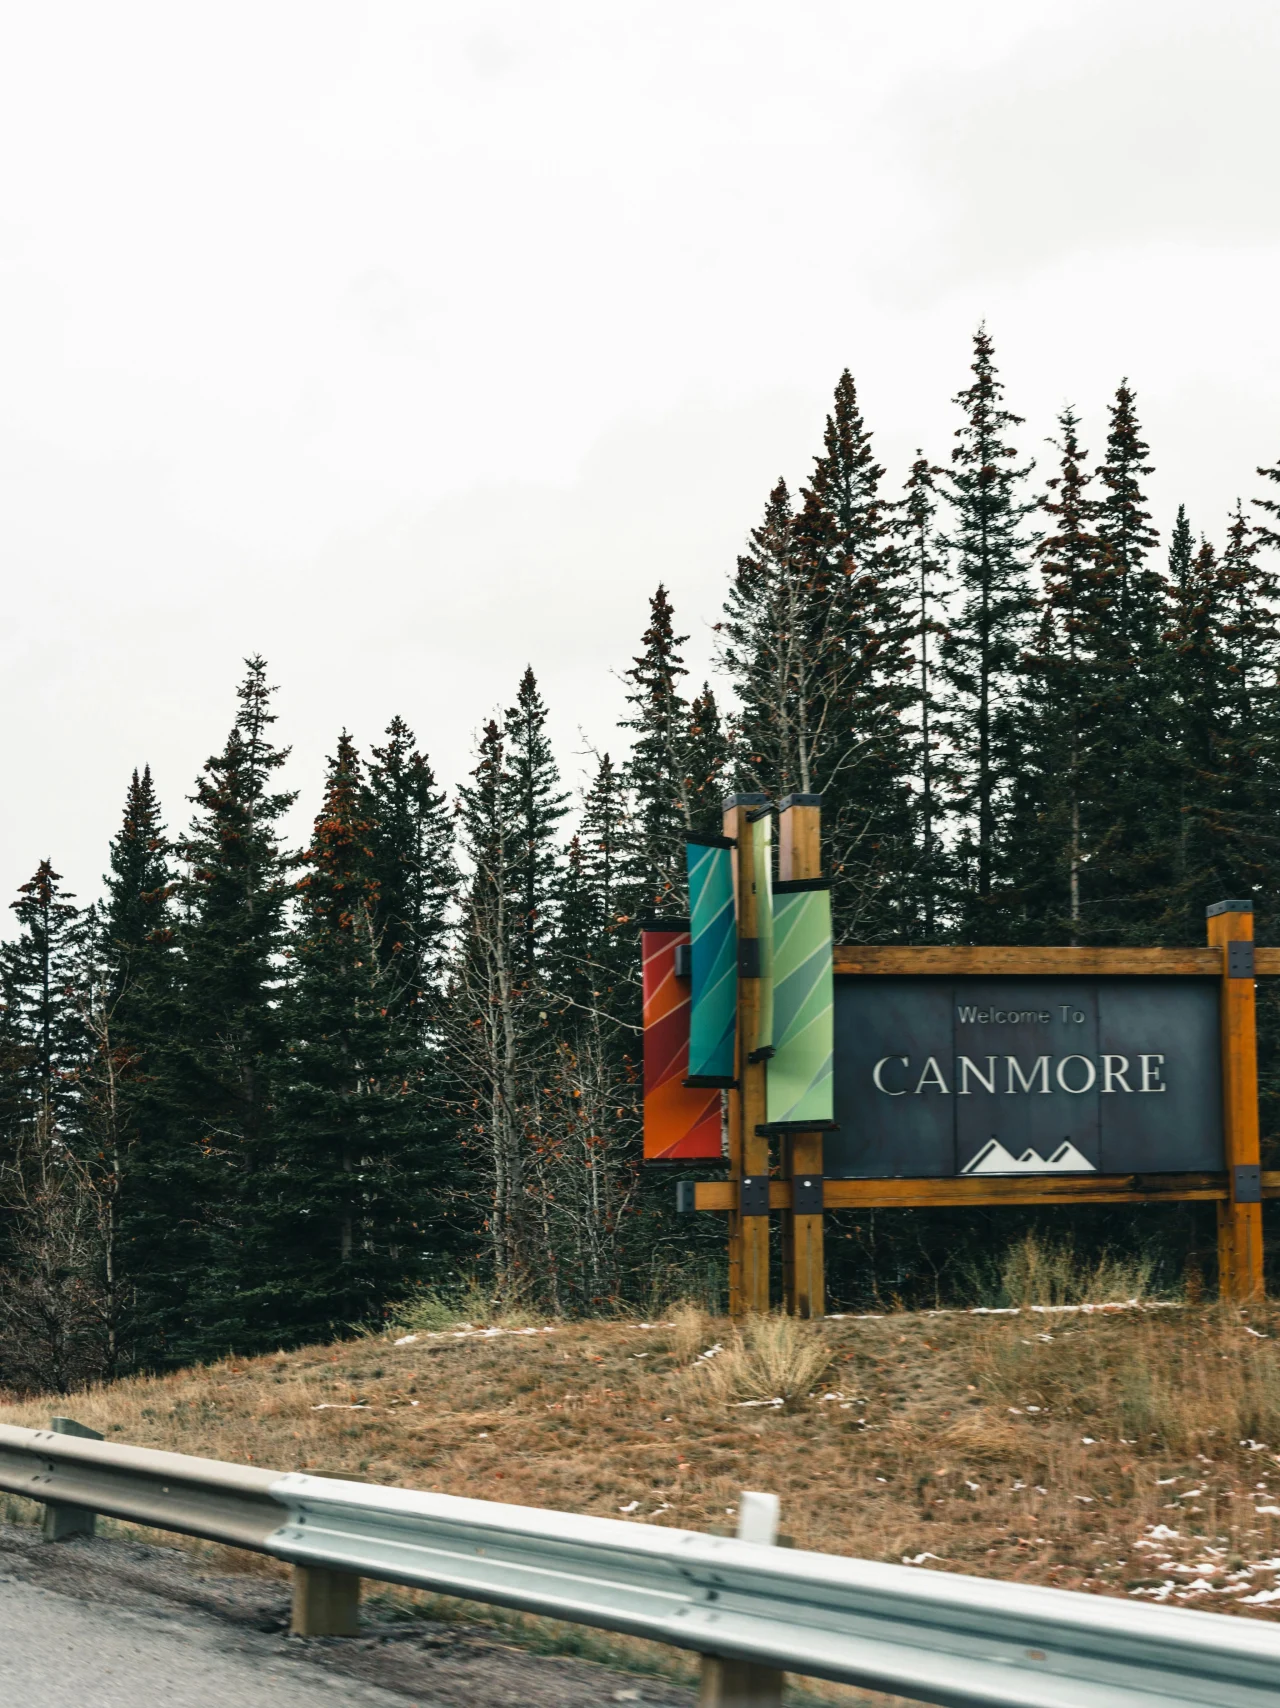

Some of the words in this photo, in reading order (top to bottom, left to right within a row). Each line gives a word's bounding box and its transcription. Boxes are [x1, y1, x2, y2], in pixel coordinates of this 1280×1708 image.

[957, 1005, 1050, 1024] Welcome
[1058, 1005, 1085, 1024] To
[872, 1054, 1167, 1096] CANMORE
